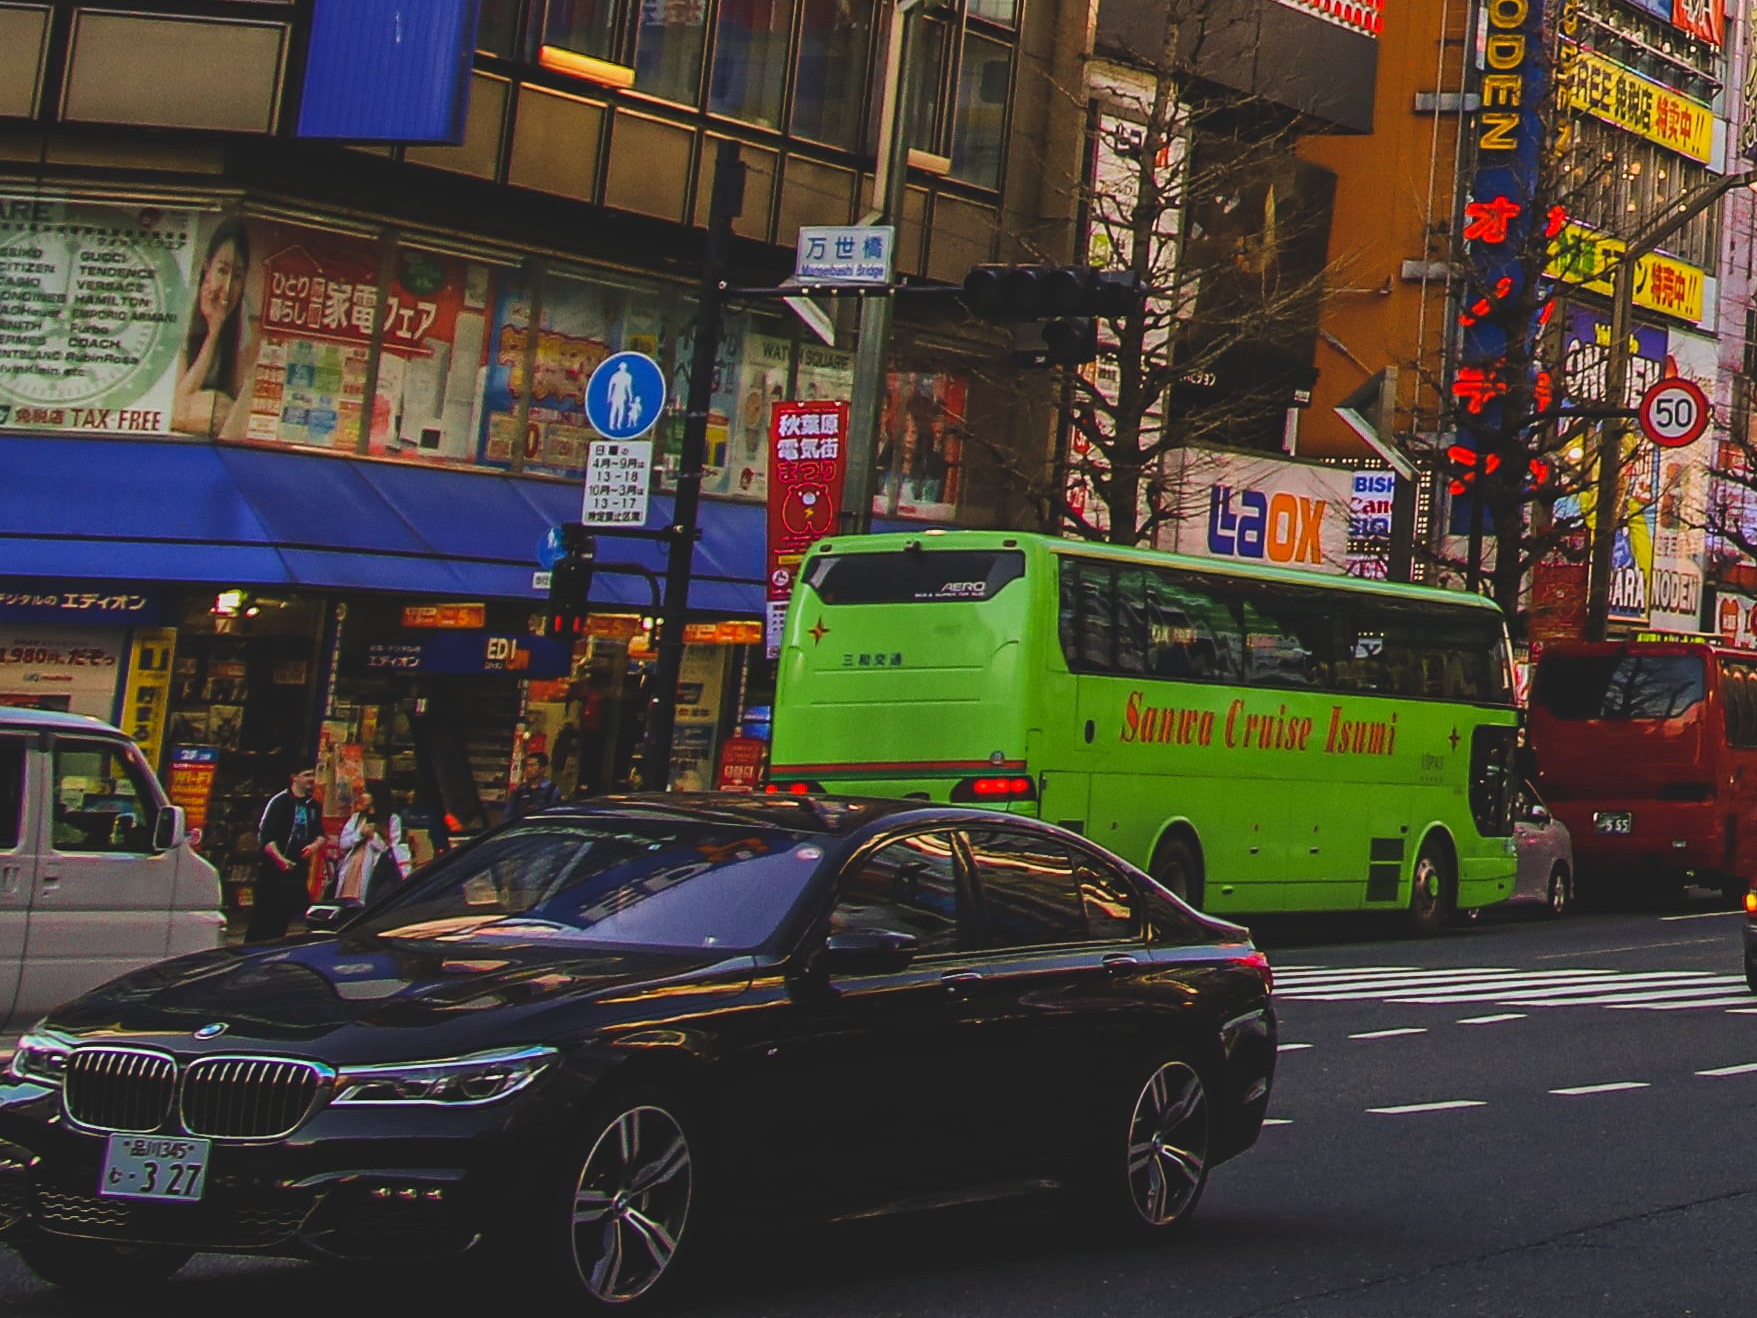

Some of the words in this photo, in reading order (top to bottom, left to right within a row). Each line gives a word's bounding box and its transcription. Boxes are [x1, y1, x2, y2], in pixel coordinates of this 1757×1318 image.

[80, 251, 127, 264] GUCCI
[806, 236, 883, 261] 万世橋
[854, 265, 884, 279] Bridge
[272, 272, 310, 298] ひとり
[75, 295, 150, 308] HAMILTON
[322, 281, 437, 341] 家電フェア
[68, 337, 121, 350] COACH
[806, 349, 853, 369] SQUARE
[71, 408, 110, 430] TAX
[118, 410, 162, 431] FREE
[779, 413, 840, 438] 秋葉原
[1656, 398, 1693, 430] 50
[777, 438, 840, 461] 電気街
[777, 461, 838, 485] まつり
[941, 581, 987, 592] AERO
[61, 593, 147, 610] エディオン
[842, 652, 904, 667] 三和交通
[1120, 690, 1213, 749] Sanwa
[1224, 699, 1313, 754] Cruise
